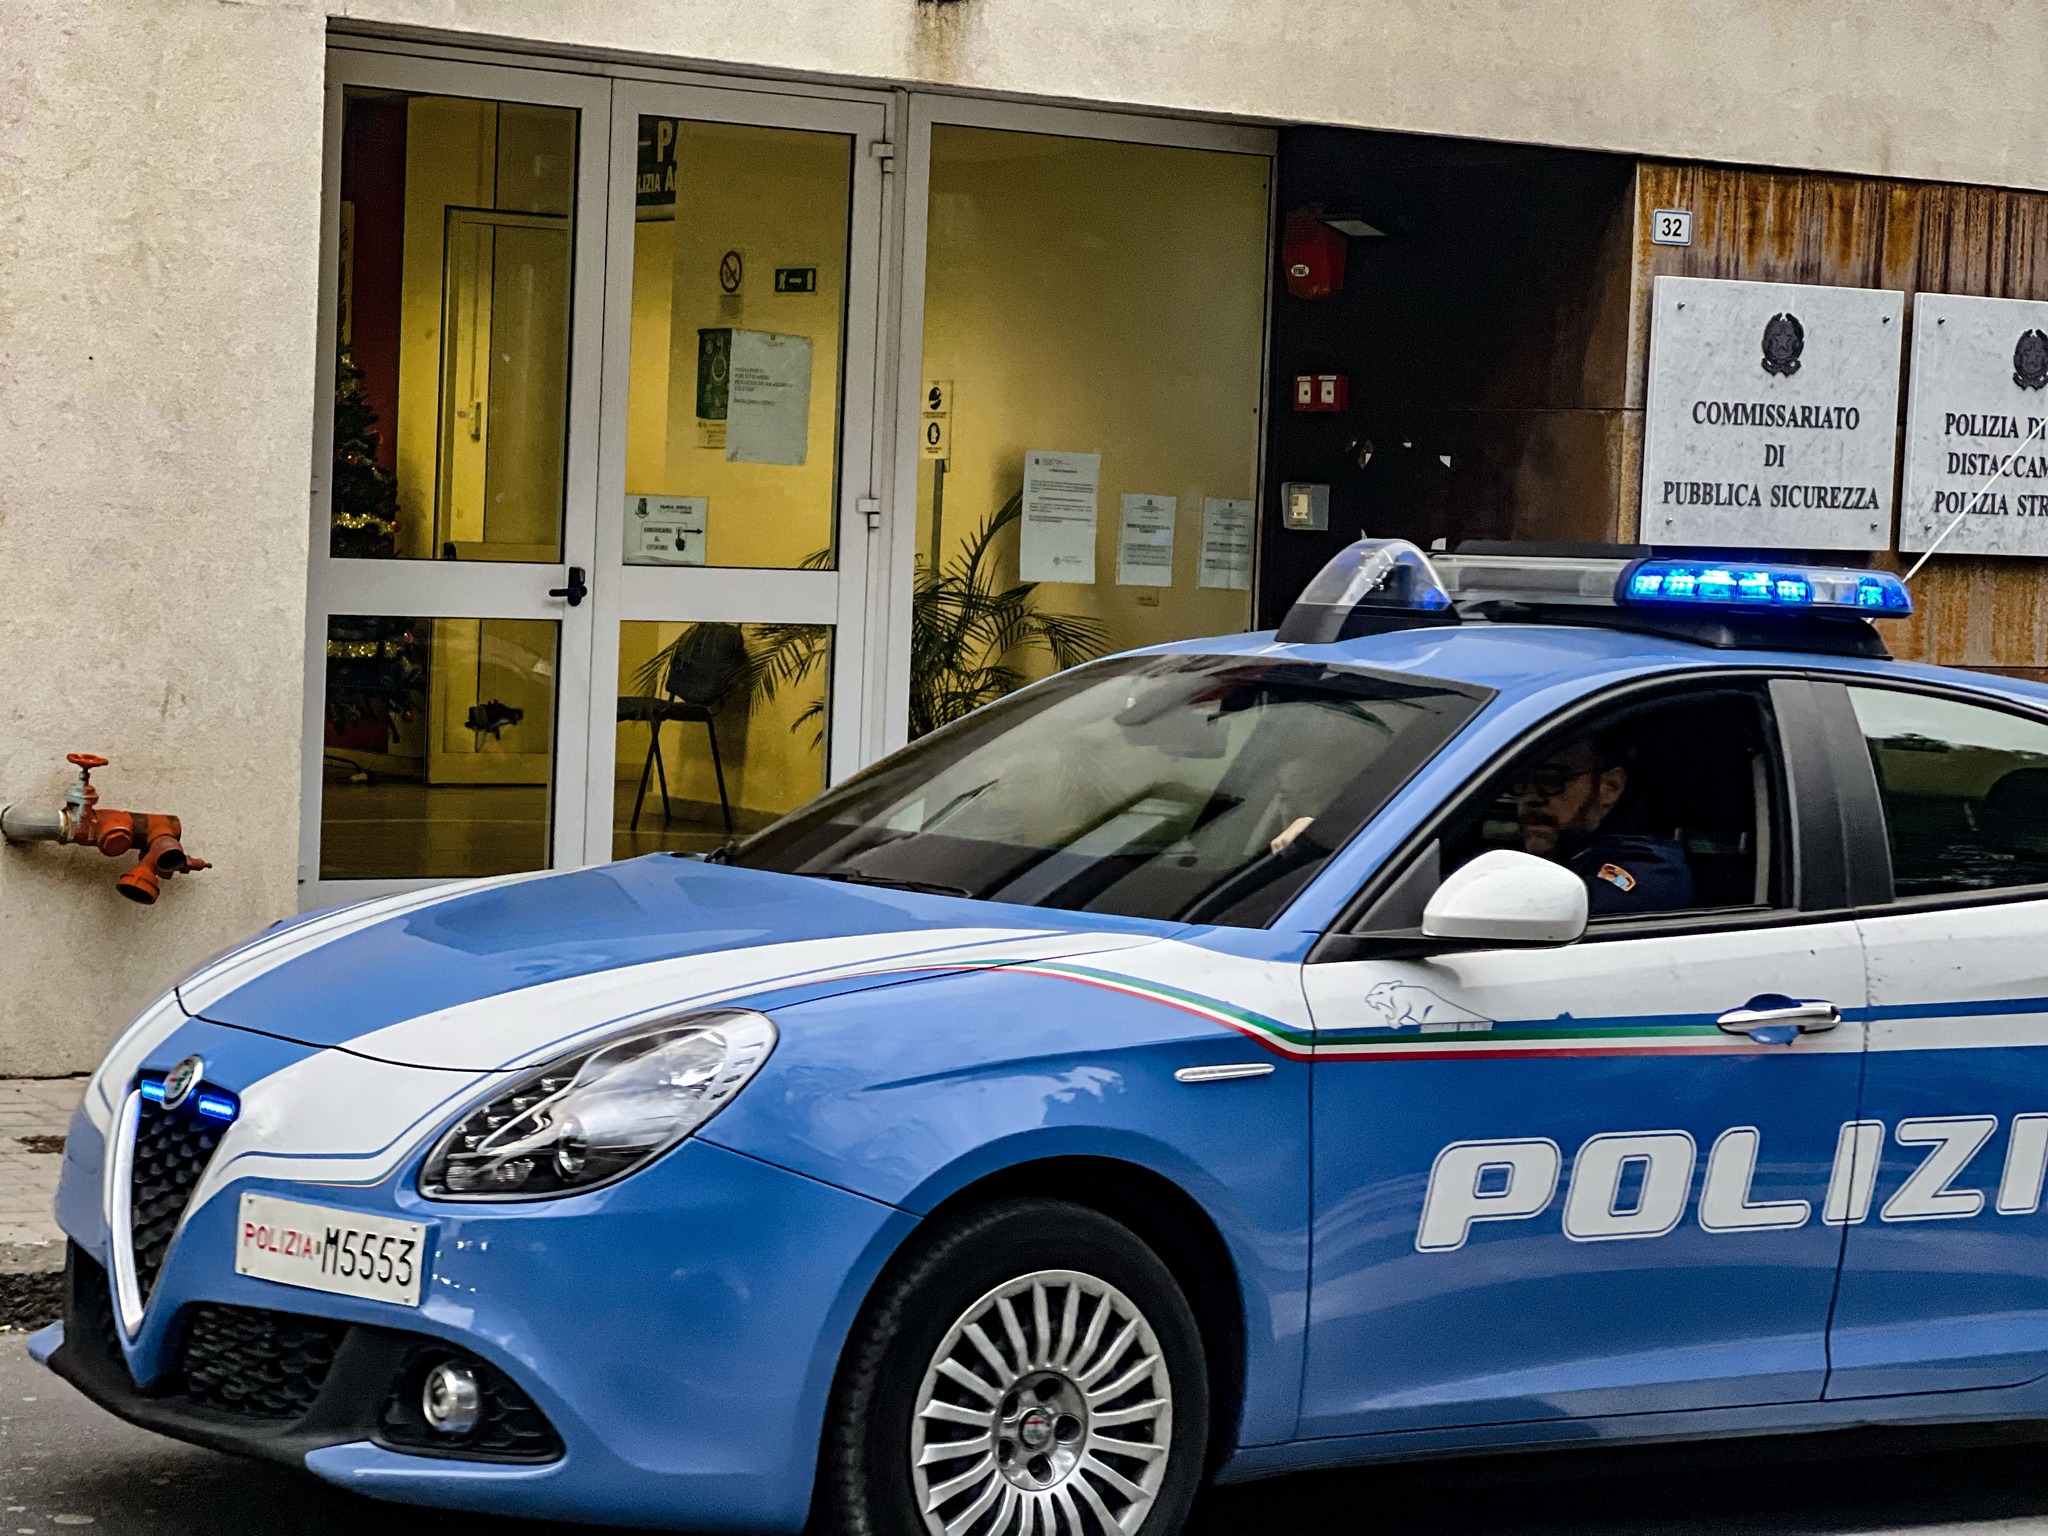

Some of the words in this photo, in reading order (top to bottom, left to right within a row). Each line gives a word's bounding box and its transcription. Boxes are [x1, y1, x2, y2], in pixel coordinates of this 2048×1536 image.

[1662, 217, 1682, 237] 32
[1692, 400, 1860, 430] COMMISSARIATO
[1944, 412, 2019, 438] POLIZIA
[1763, 443, 1786, 467] DI
[1662, 481, 1762, 507] PUBBLICA
[1770, 484, 1880, 510] SICUREZZA
[1934, 491, 2009, 515] POLIZIA
[1415, 1112, 2048, 1253] POLIZI
[244, 1222, 313, 1260] POLIZIA
[321, 1225, 416, 1287] M5553
